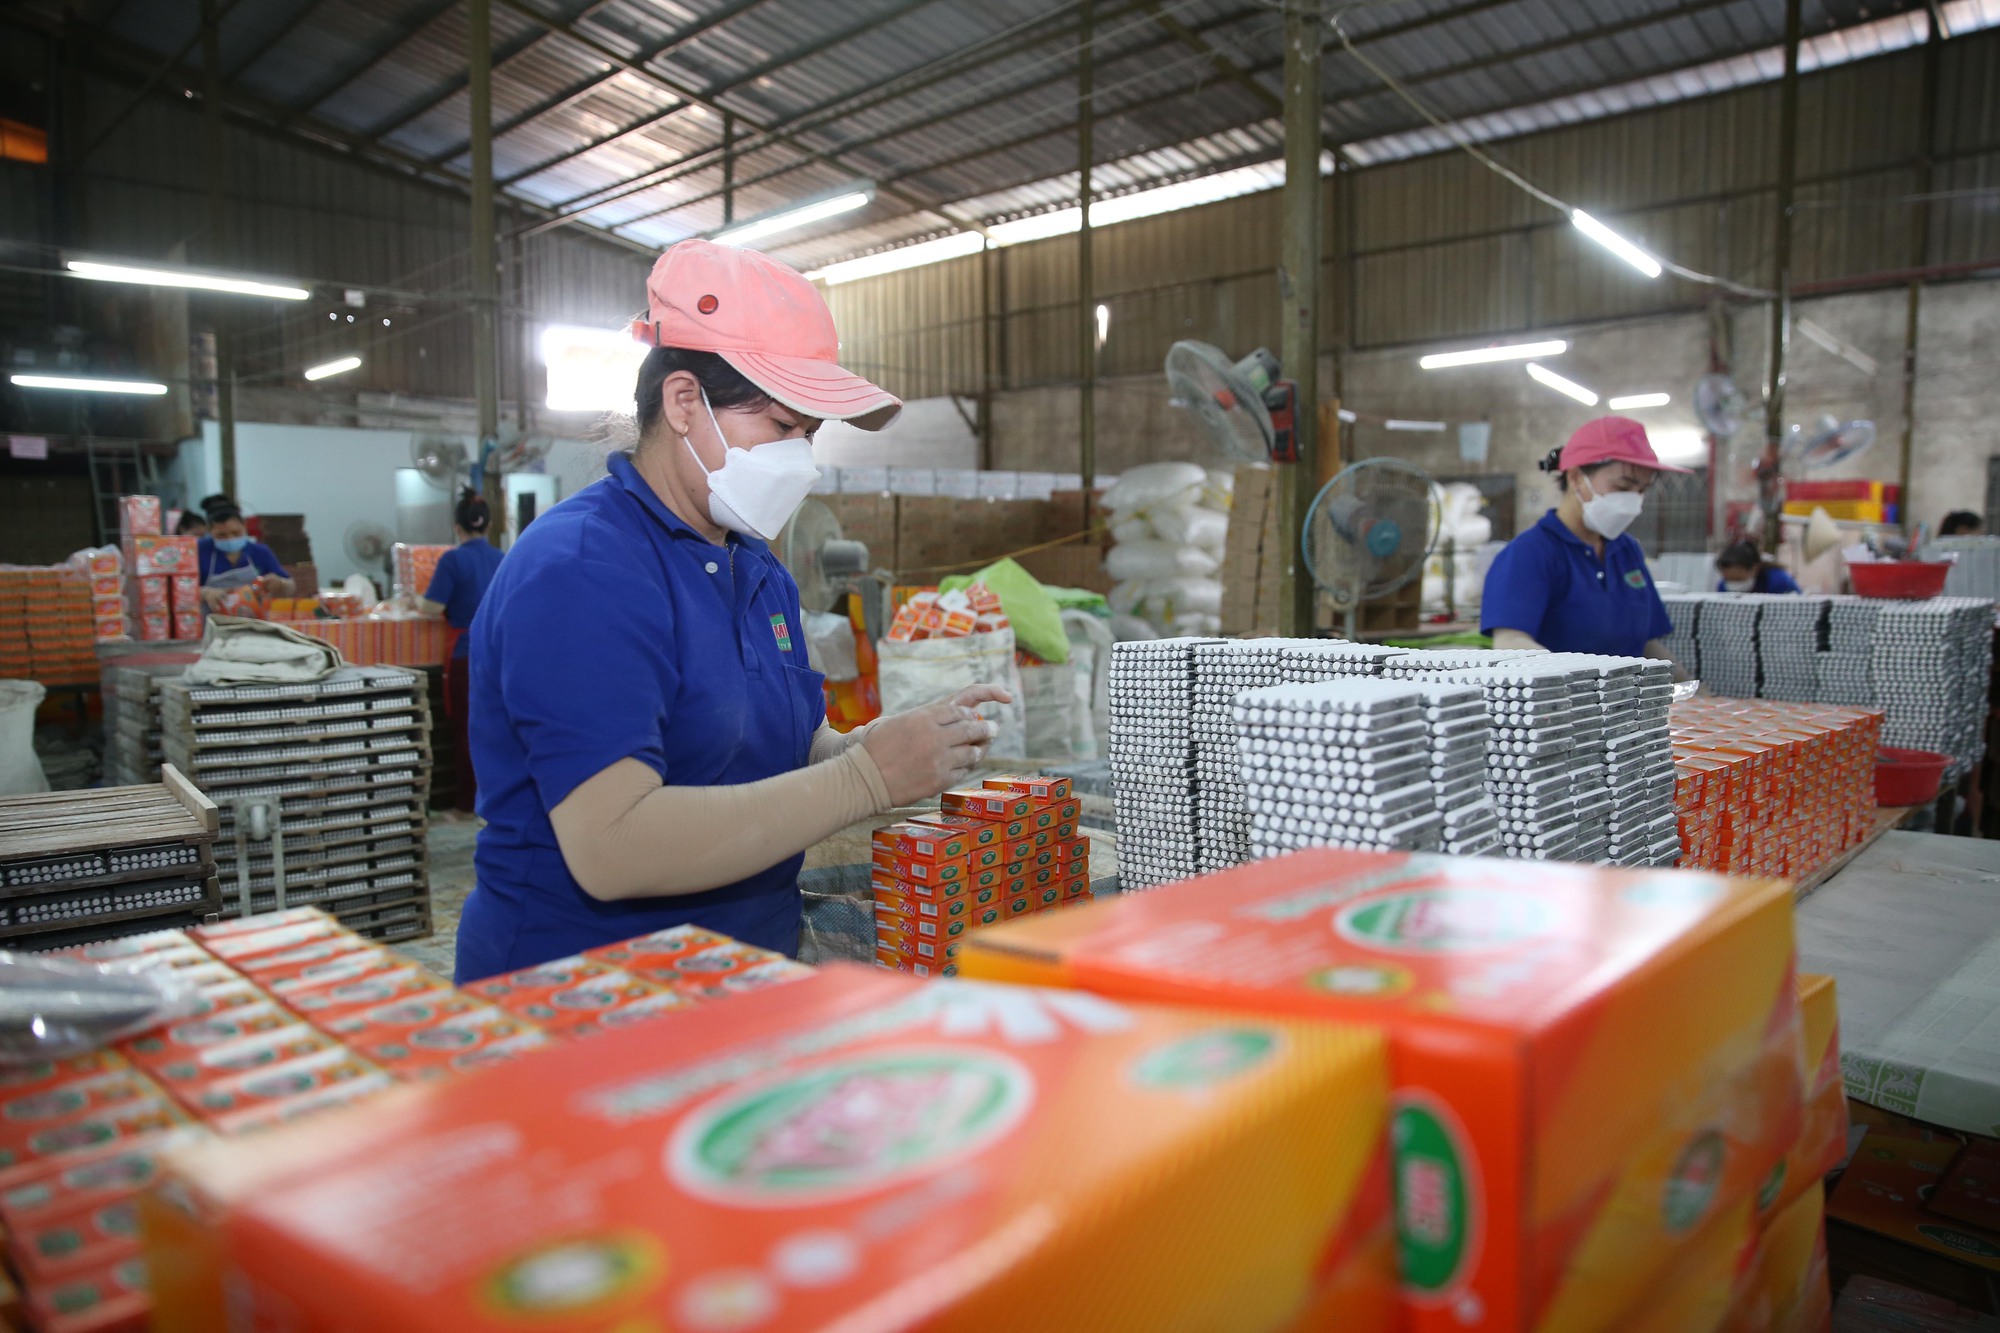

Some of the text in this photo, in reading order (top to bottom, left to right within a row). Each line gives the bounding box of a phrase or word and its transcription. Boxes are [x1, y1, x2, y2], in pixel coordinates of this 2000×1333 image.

[773, 623, 789, 639] MI
[965, 800, 982, 815] 221
[899, 900, 916, 917] 221
